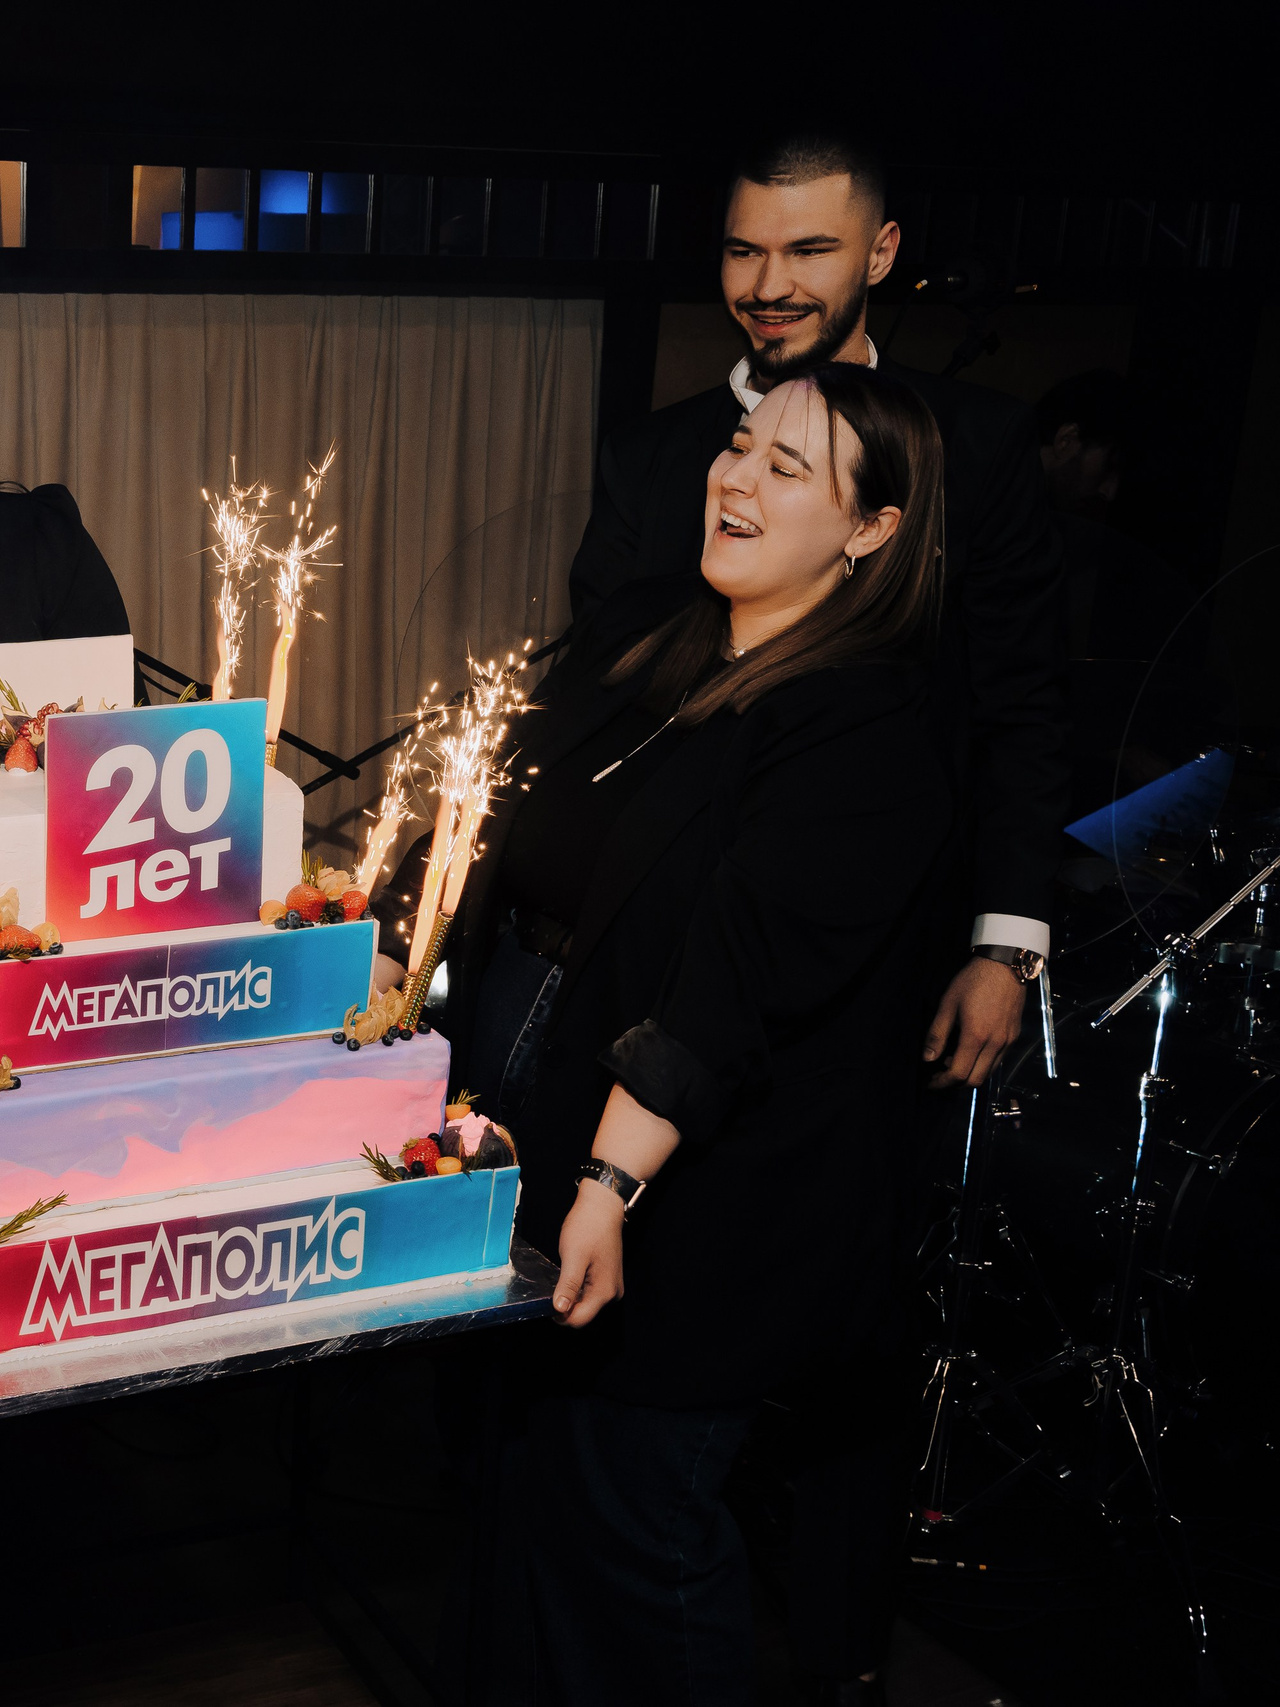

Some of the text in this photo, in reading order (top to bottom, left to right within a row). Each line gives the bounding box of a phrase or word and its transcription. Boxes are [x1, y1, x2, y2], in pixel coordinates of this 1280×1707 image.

[82, 728, 232, 855] 20
[80, 837, 231, 919] лет
[27, 959, 273, 1041] МЕГАПОЛИС
[19, 1196, 366, 1342] МЕГАПОЛИС
